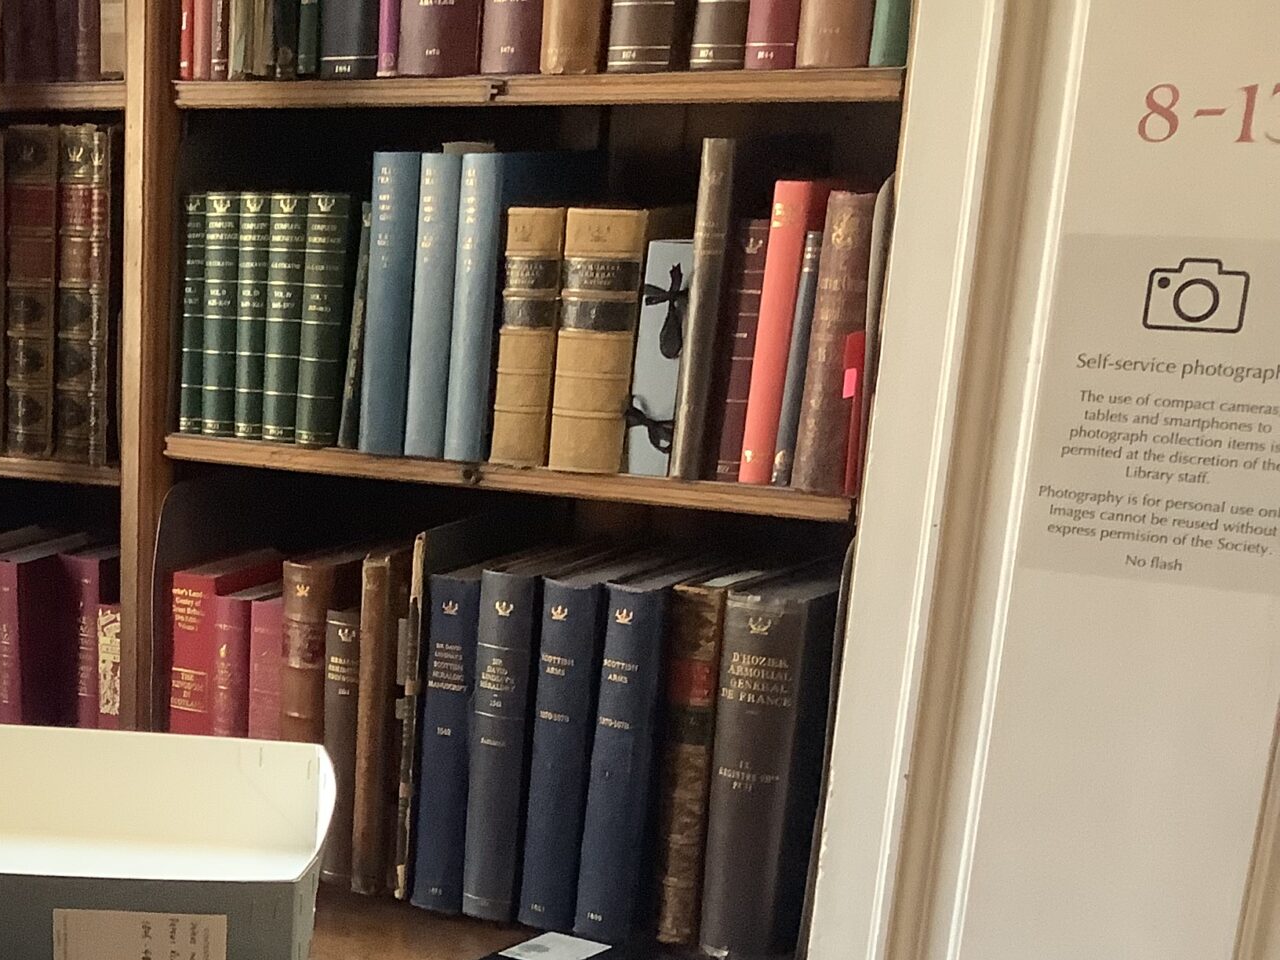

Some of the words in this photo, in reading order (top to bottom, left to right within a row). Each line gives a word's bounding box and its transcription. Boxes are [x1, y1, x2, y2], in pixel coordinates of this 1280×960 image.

[1076, 353, 1177, 374] Self-service
[1079, 389, 1104, 404] The
[1109, 394, 1132, 405] use
[1136, 393, 1150, 406] of
[1154, 396, 1215, 411] compact
[1084, 409, 1128, 423] tablets
[1133, 413, 1159, 426] and
[1163, 417, 1253, 433] smartphones
[1257, 422, 1272, 433] to
[1069, 426, 1148, 445] photograph
[1153, 432, 1223, 448] collection
[1227, 438, 1266, 452] items
[1061, 445, 1122, 459] permited
[1126, 450, 1139, 461] at
[1143, 449, 1165, 462] the
[1169, 452, 1238, 468] discretion
[1243, 457, 1259, 470] of
[1126, 466, 1174, 484] Library
[1178, 470, 1210, 484] staff.
[1039, 485, 1122, 507] Photography
[1127, 492, 1138, 505] is
[1143, 494, 1161, 507] for
[1165, 499, 1226, 514] personal
[1230, 505, 1254, 517] use
[1049, 504, 1096, 521] Images
[1100, 511, 1147, 524] cannot
[1150, 513, 1168, 526] be
[1172, 517, 1219, 531] reused
[1223, 521, 1278, 537] without
[1047, 523, 1096, 538] express
[1173, 533, 1188, 546] of
[1191, 535, 1213, 549] the
[1217, 537, 1273, 557] Society.
[1125, 554, 1147, 568] No
[1150, 556, 1183, 572] flash
[541, 653, 574, 667] SCOTTISH
[603, 658, 639, 672] SCOTTISH
[545, 666, 565, 676] ARMS
[607, 673, 628, 684] ARMS
[727, 665, 792, 682] ARMORIAL
[730, 677, 788, 694] GENERAL
[720, 687, 734, 700] DE
[739, 691, 793, 707] FRANCE
